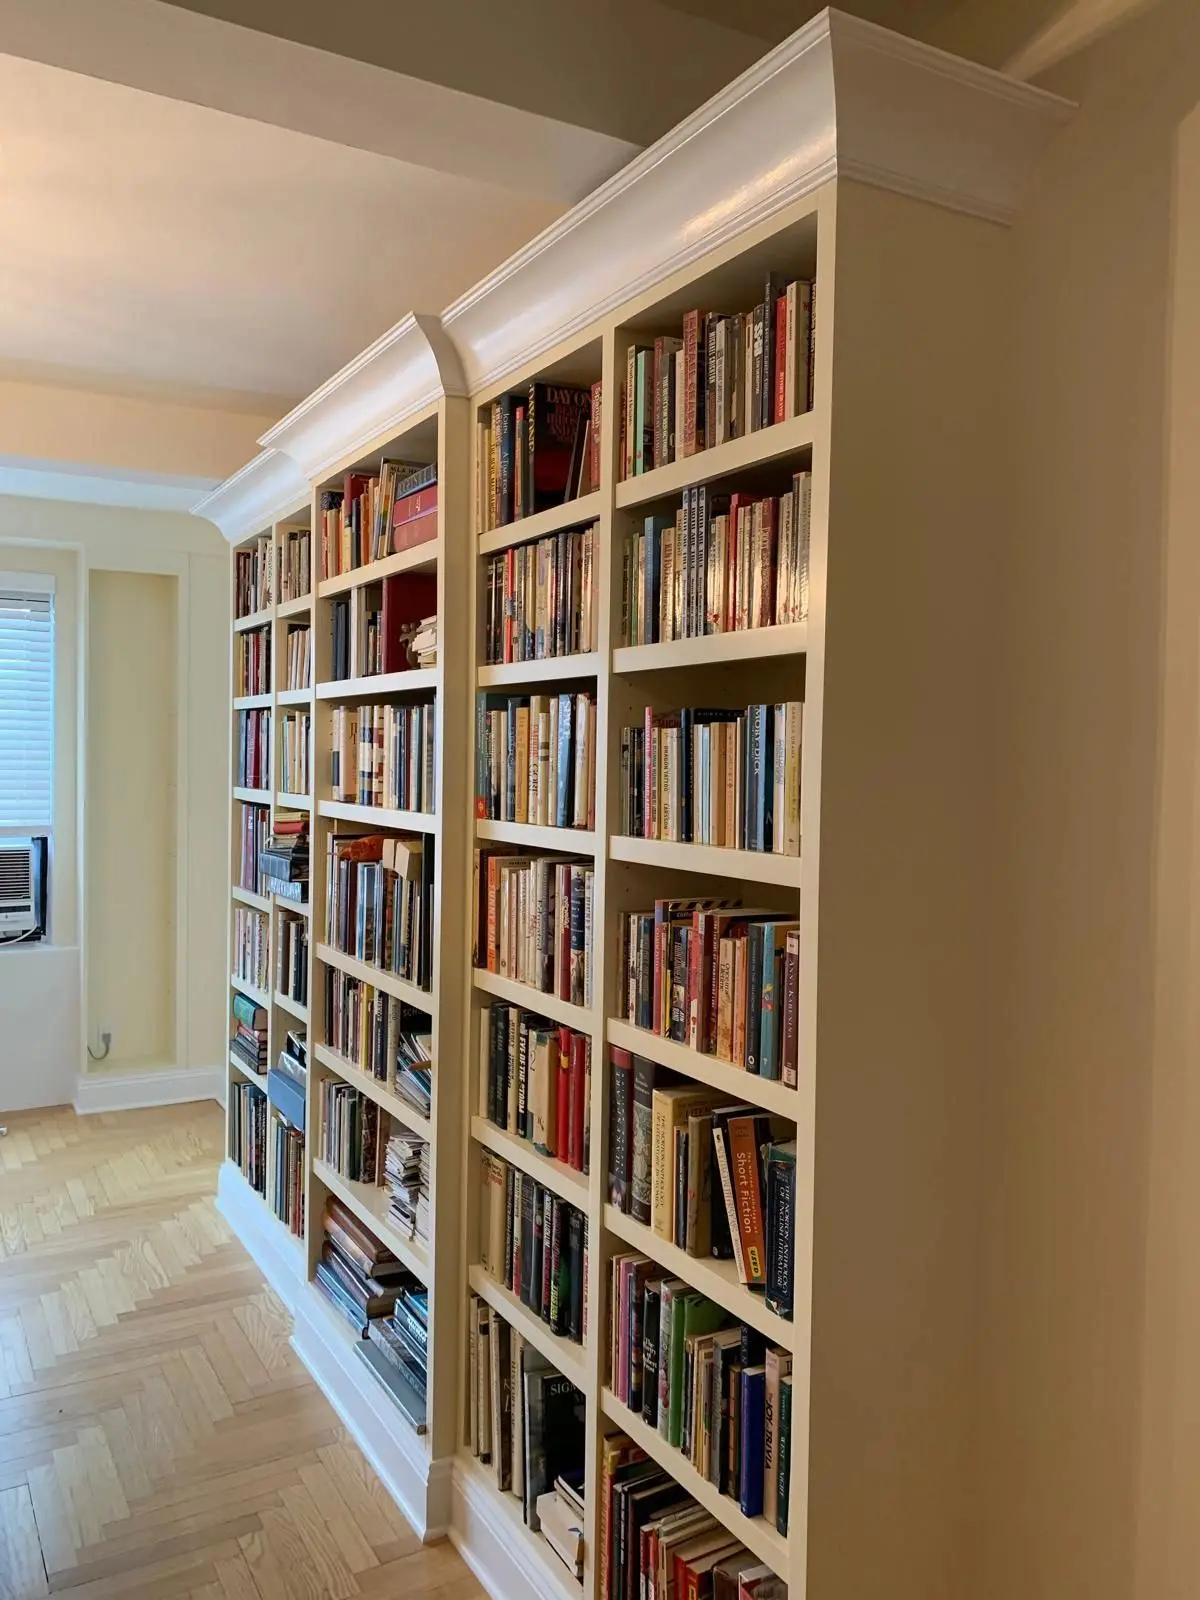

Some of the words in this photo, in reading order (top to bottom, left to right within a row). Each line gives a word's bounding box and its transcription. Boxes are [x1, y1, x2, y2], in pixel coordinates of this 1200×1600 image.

[736, 1152, 748, 1186] Short
[740, 1190, 752, 1234] Fiction
[751, 1250, 759, 1274] USED
[781, 1241, 789, 1295] ANTHOLOGY
[765, 1400, 773, 1424] JOY
[765, 1430, 773, 1470] TRIVIA
